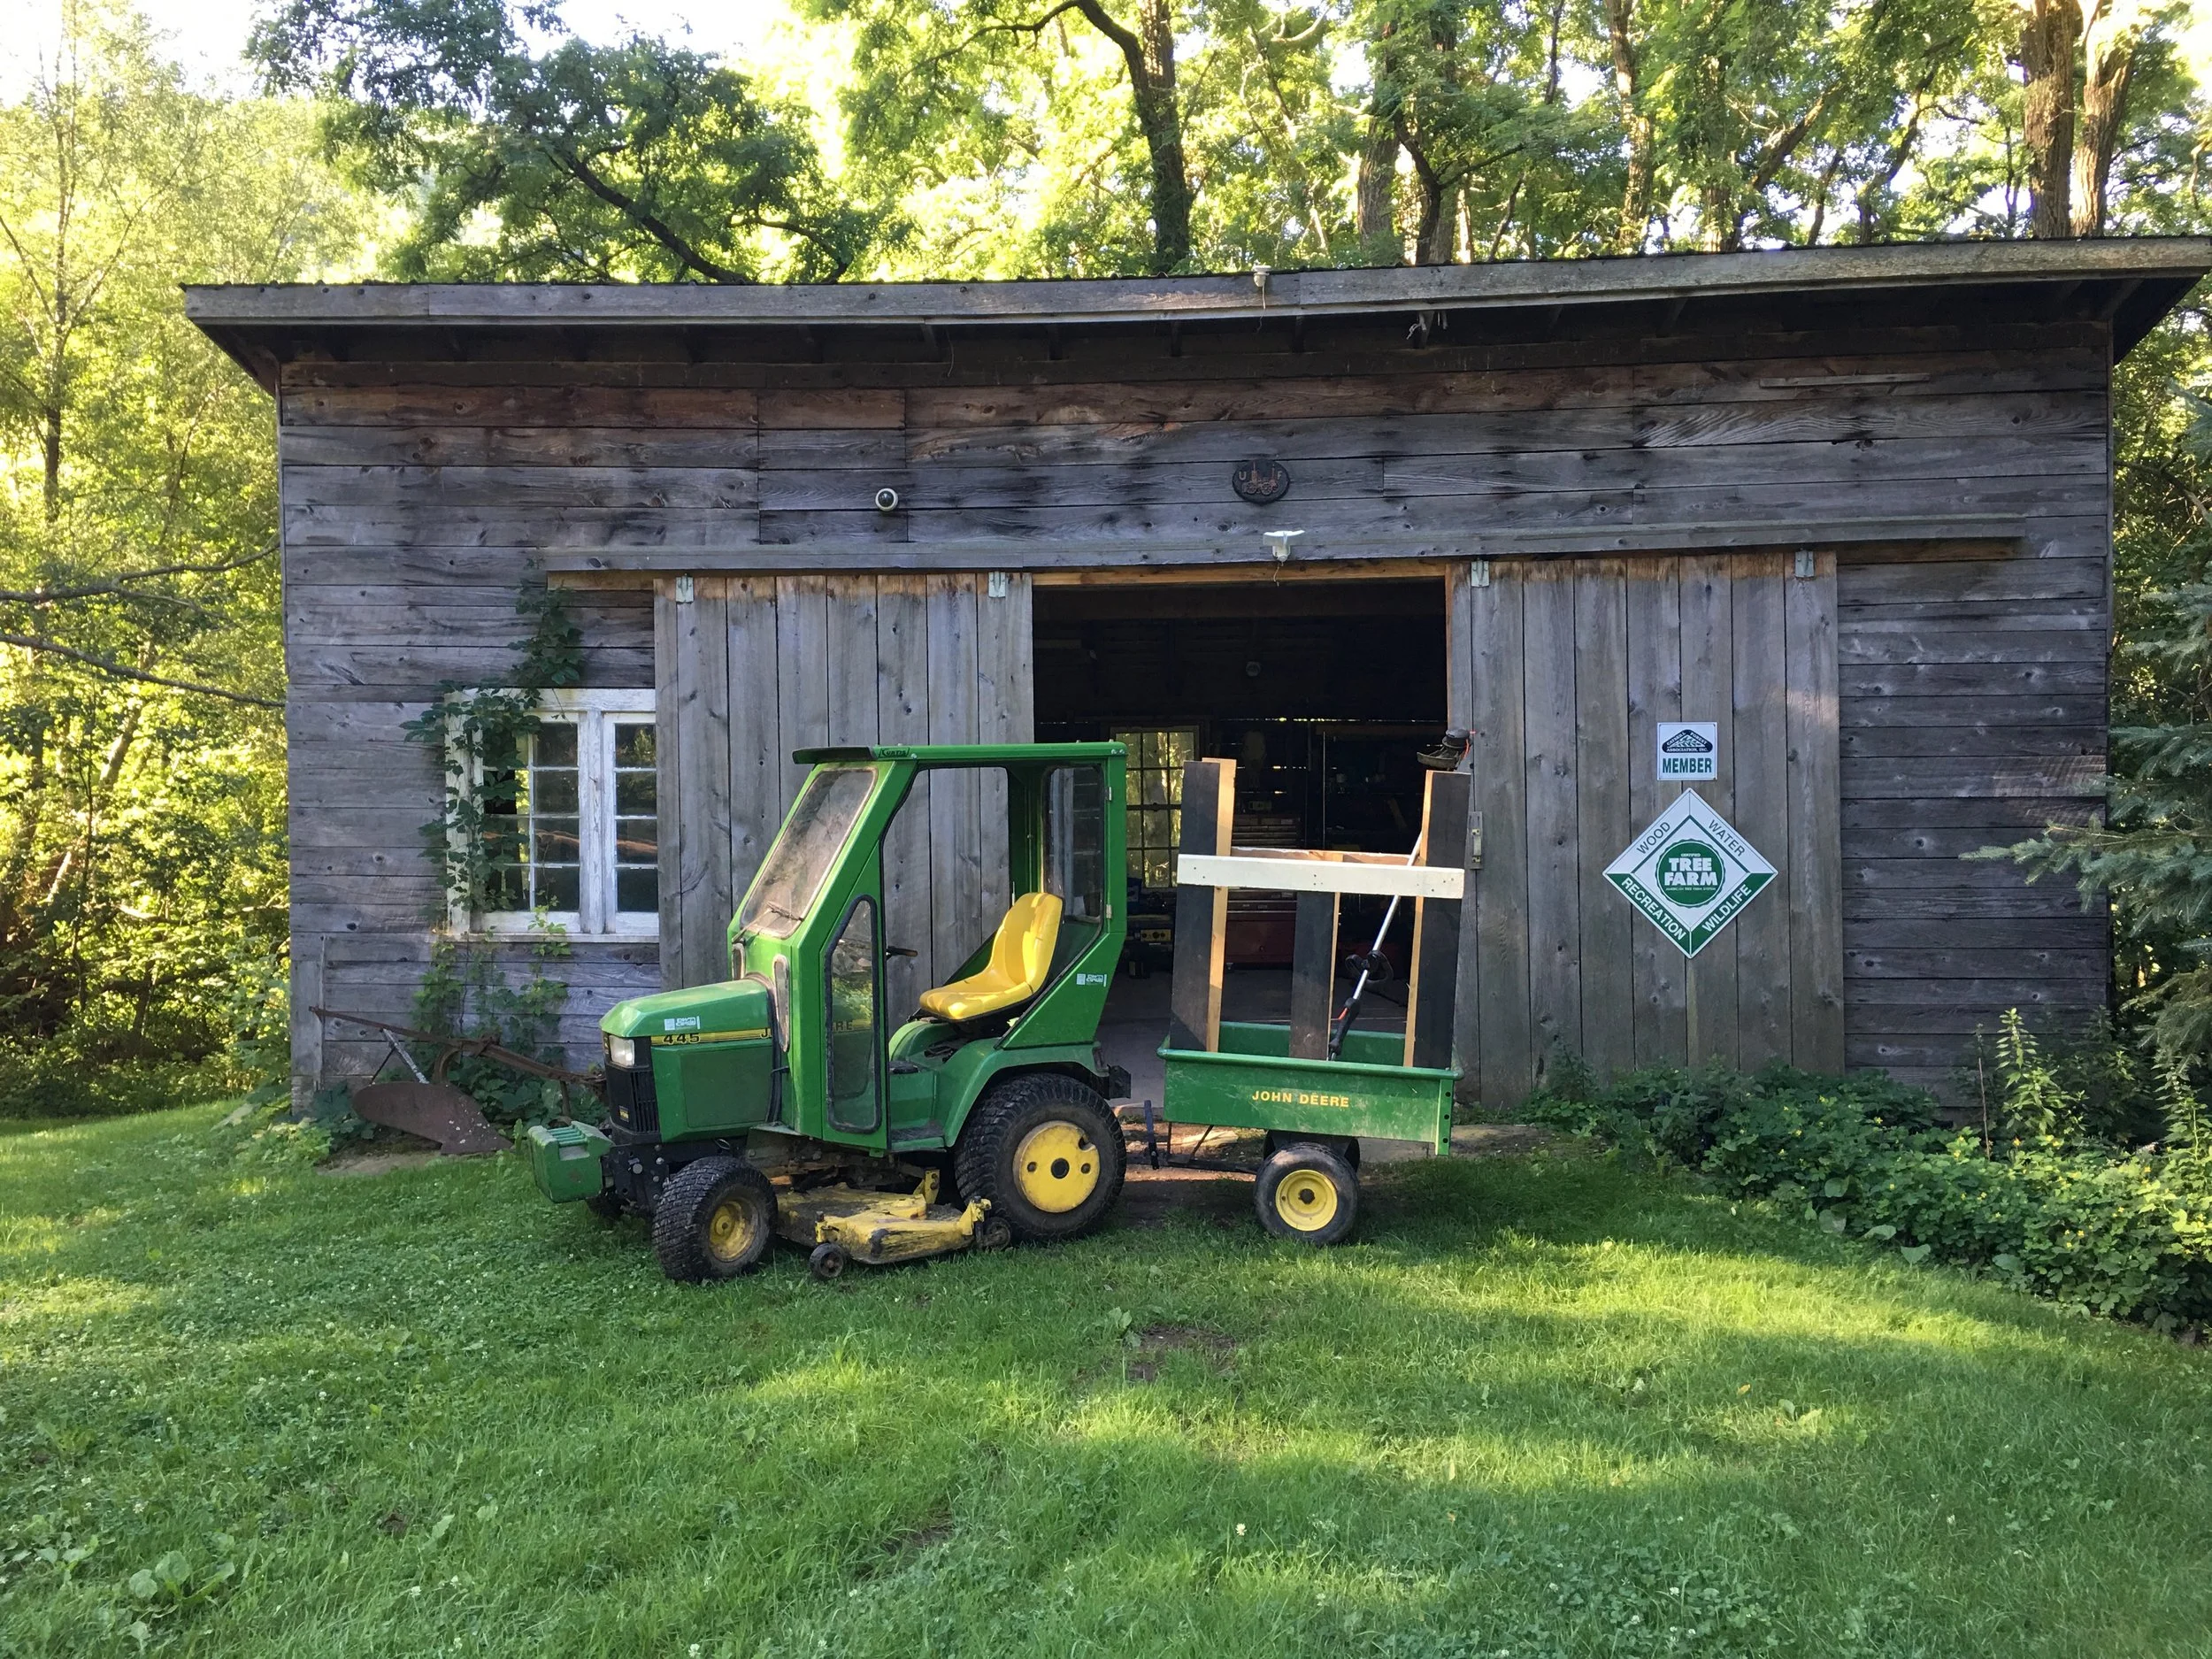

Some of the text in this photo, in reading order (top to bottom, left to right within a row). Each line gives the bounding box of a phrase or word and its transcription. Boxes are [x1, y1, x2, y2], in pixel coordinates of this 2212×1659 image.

[1662, 757, 1712, 773] MEMBER
[1636, 821, 1671, 855] WOOD
[1708, 819, 1746, 857] WATER
[1669, 857, 1712, 872] TREE
[1664, 872, 1718, 886] FARM
[1620, 877, 1686, 941] RECREATION
[1701, 883, 1753, 933] WILDLIFE
[663, 1033, 700, 1044] 445
[1252, 1090, 1350, 1108] JOHN DEERE
